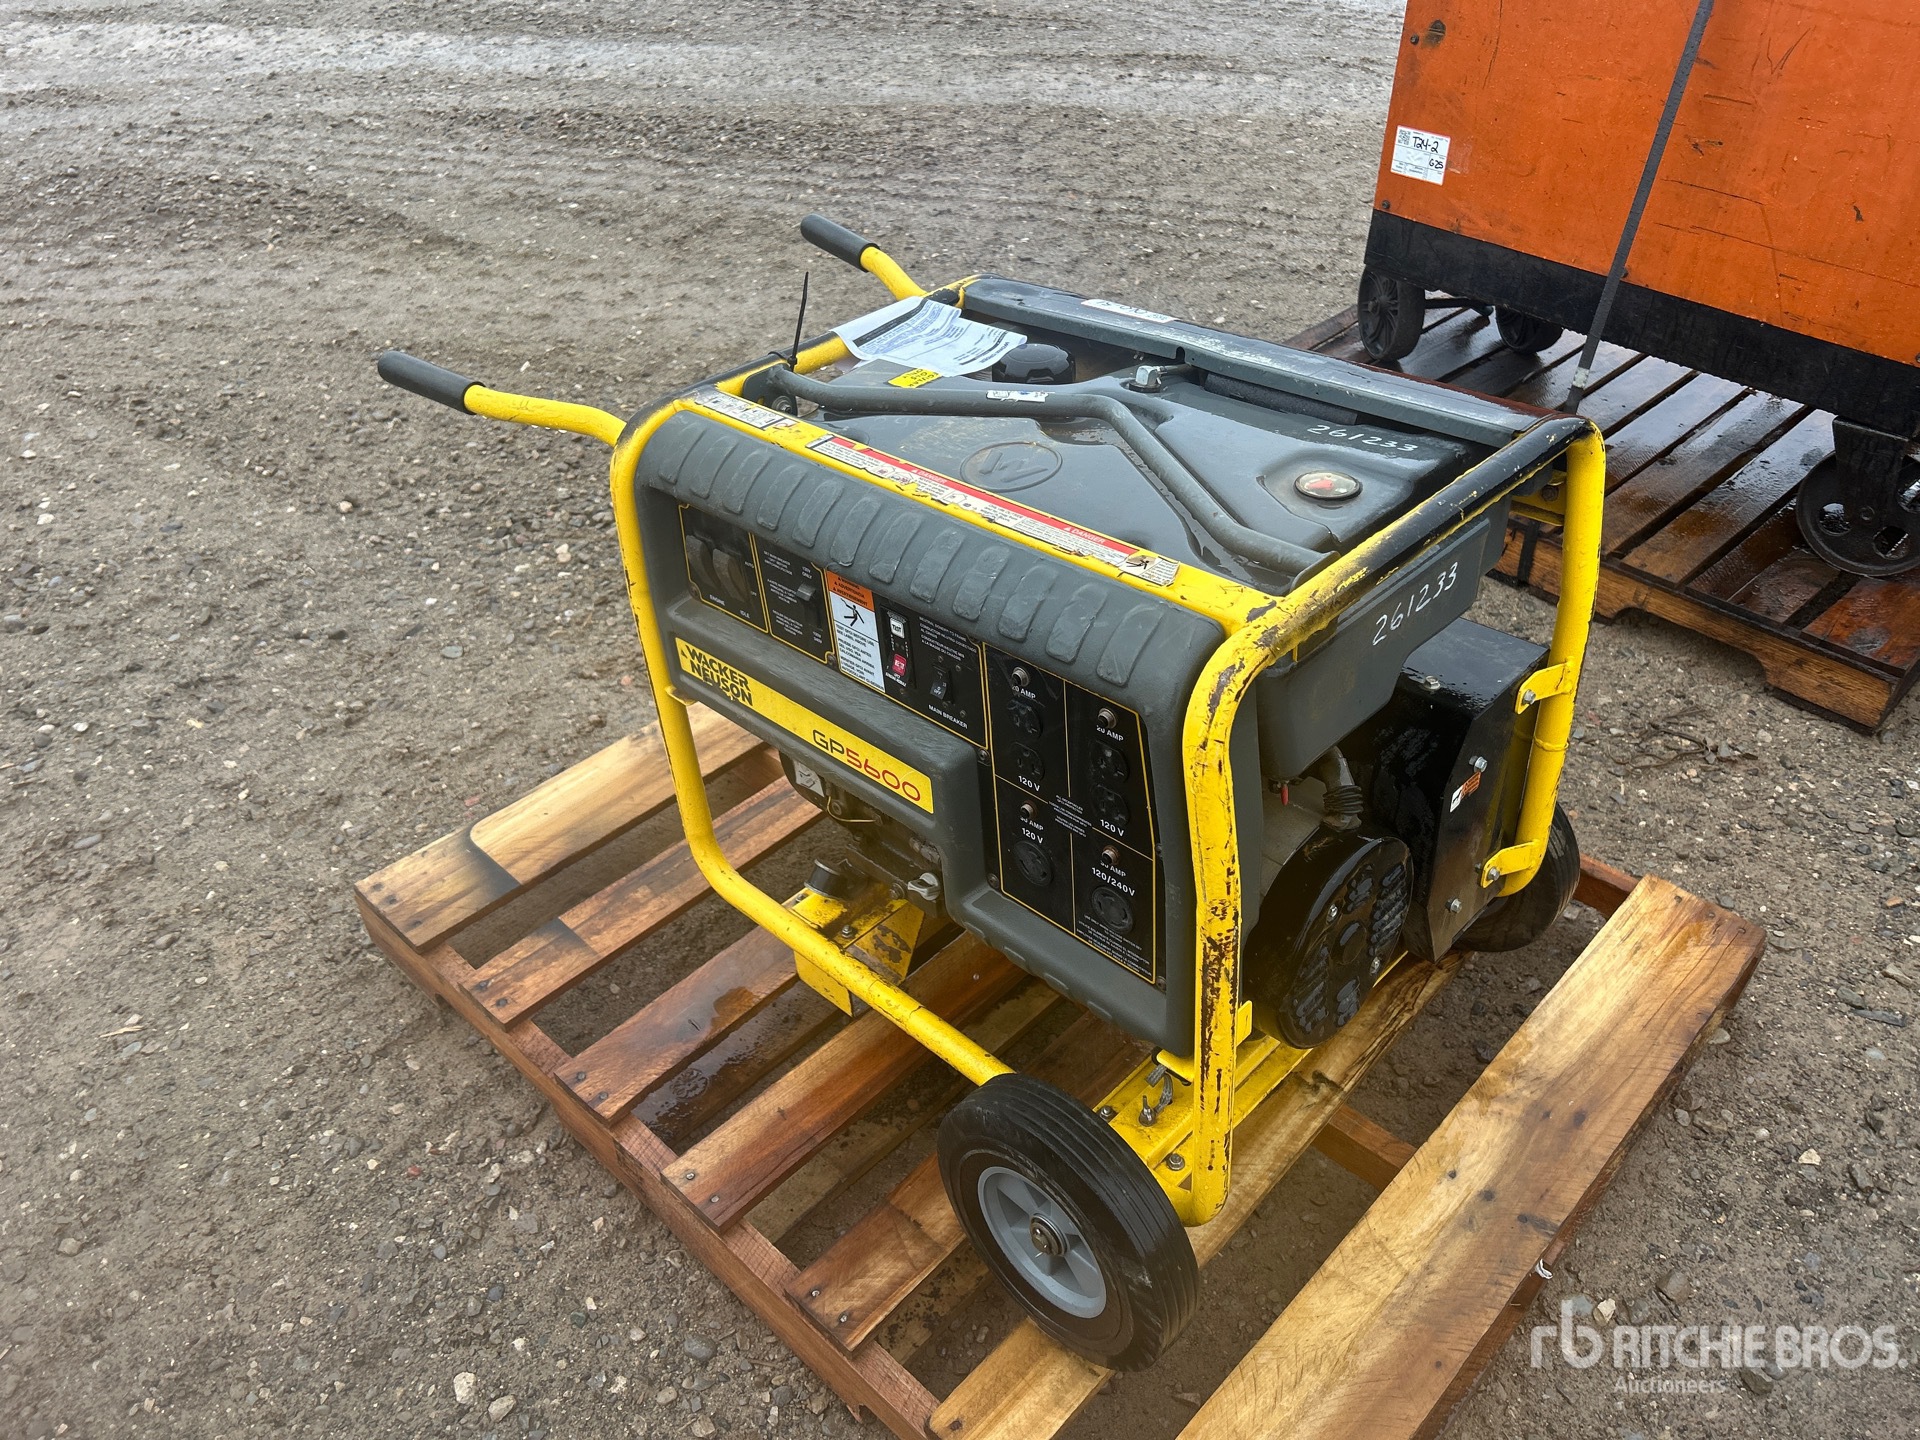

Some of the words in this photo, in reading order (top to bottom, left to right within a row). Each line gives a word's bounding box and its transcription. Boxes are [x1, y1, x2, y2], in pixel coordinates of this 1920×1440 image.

[1412, 136, 1439, 154] T24-2
[1306, 424, 1418, 453] 261233
[1071, 528, 1106, 544] DANGER
[1372, 561, 1458, 646] 261233
[685, 644, 750, 688] WACKER
[690, 658, 754, 708] NEUSON
[1020, 688, 1036, 699] AMP
[928, 704, 943, 716] MAIN
[942, 712, 968, 730] BREAKER
[1106, 730, 1124, 742] AMP
[812, 729, 921, 802] GP5600
[1028, 820, 1044, 830] AMP
[1091, 868, 1136, 896] 120/240V
[1110, 866, 1126, 877] AMP
